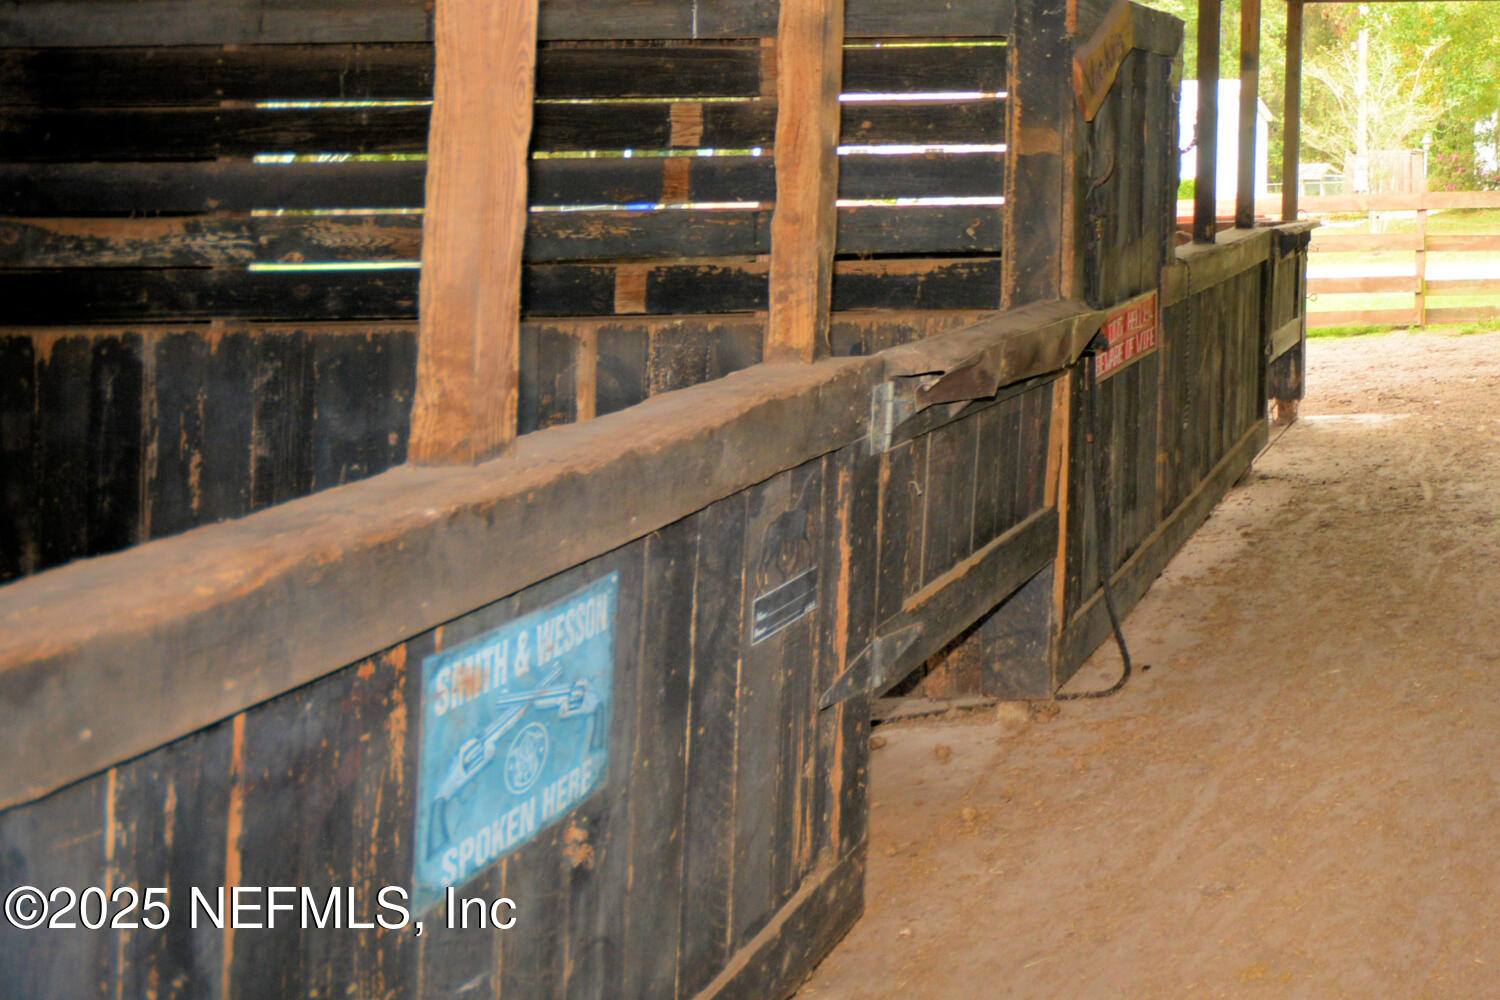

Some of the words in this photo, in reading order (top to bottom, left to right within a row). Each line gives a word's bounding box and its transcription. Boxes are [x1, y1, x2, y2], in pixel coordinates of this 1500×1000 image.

[433, 638, 509, 718] SMITH
[513, 630, 530, 679] &
[535, 593, 609, 668] WESSON
[440, 797, 536, 883] SPOKEN
[542, 758, 593, 820] HERE
